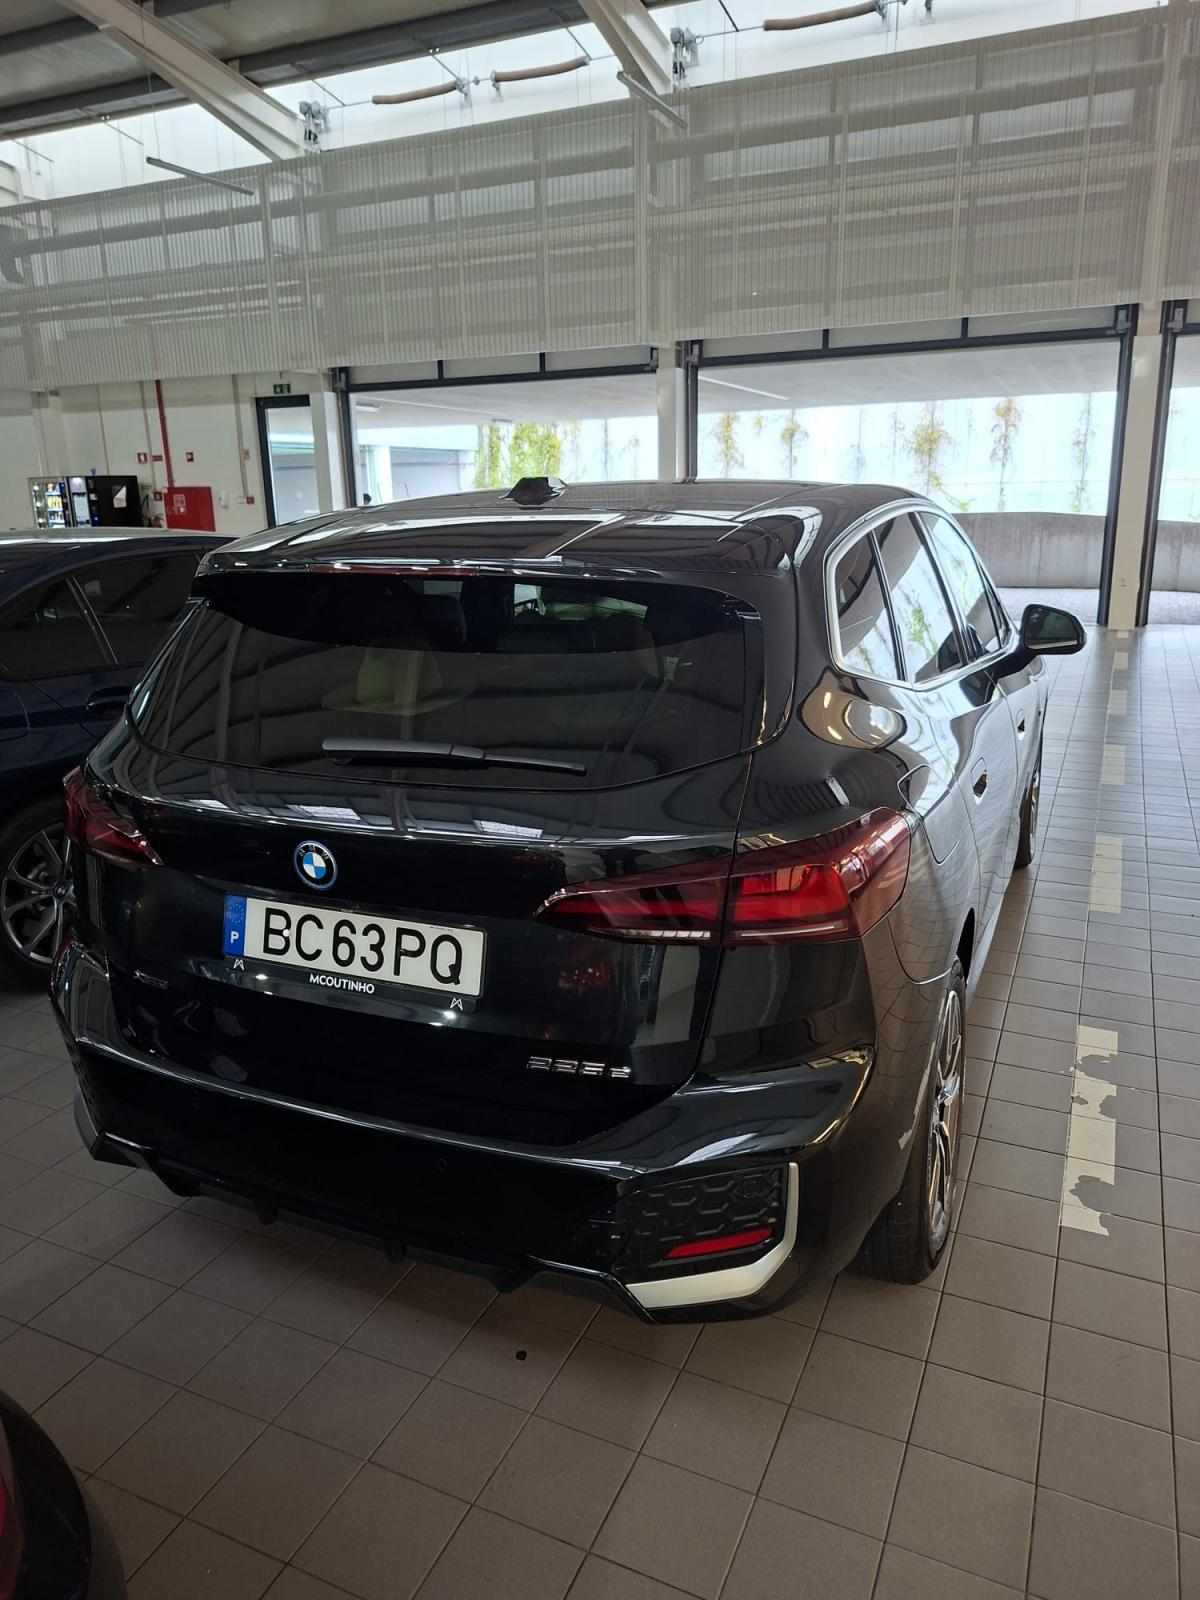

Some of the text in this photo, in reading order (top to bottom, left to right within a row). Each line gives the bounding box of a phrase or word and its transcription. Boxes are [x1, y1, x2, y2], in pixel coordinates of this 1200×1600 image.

[230, 931, 240, 944] P
[262, 907, 463, 986] BC63PQ
[309, 973, 375, 994] MCOUTINHO
